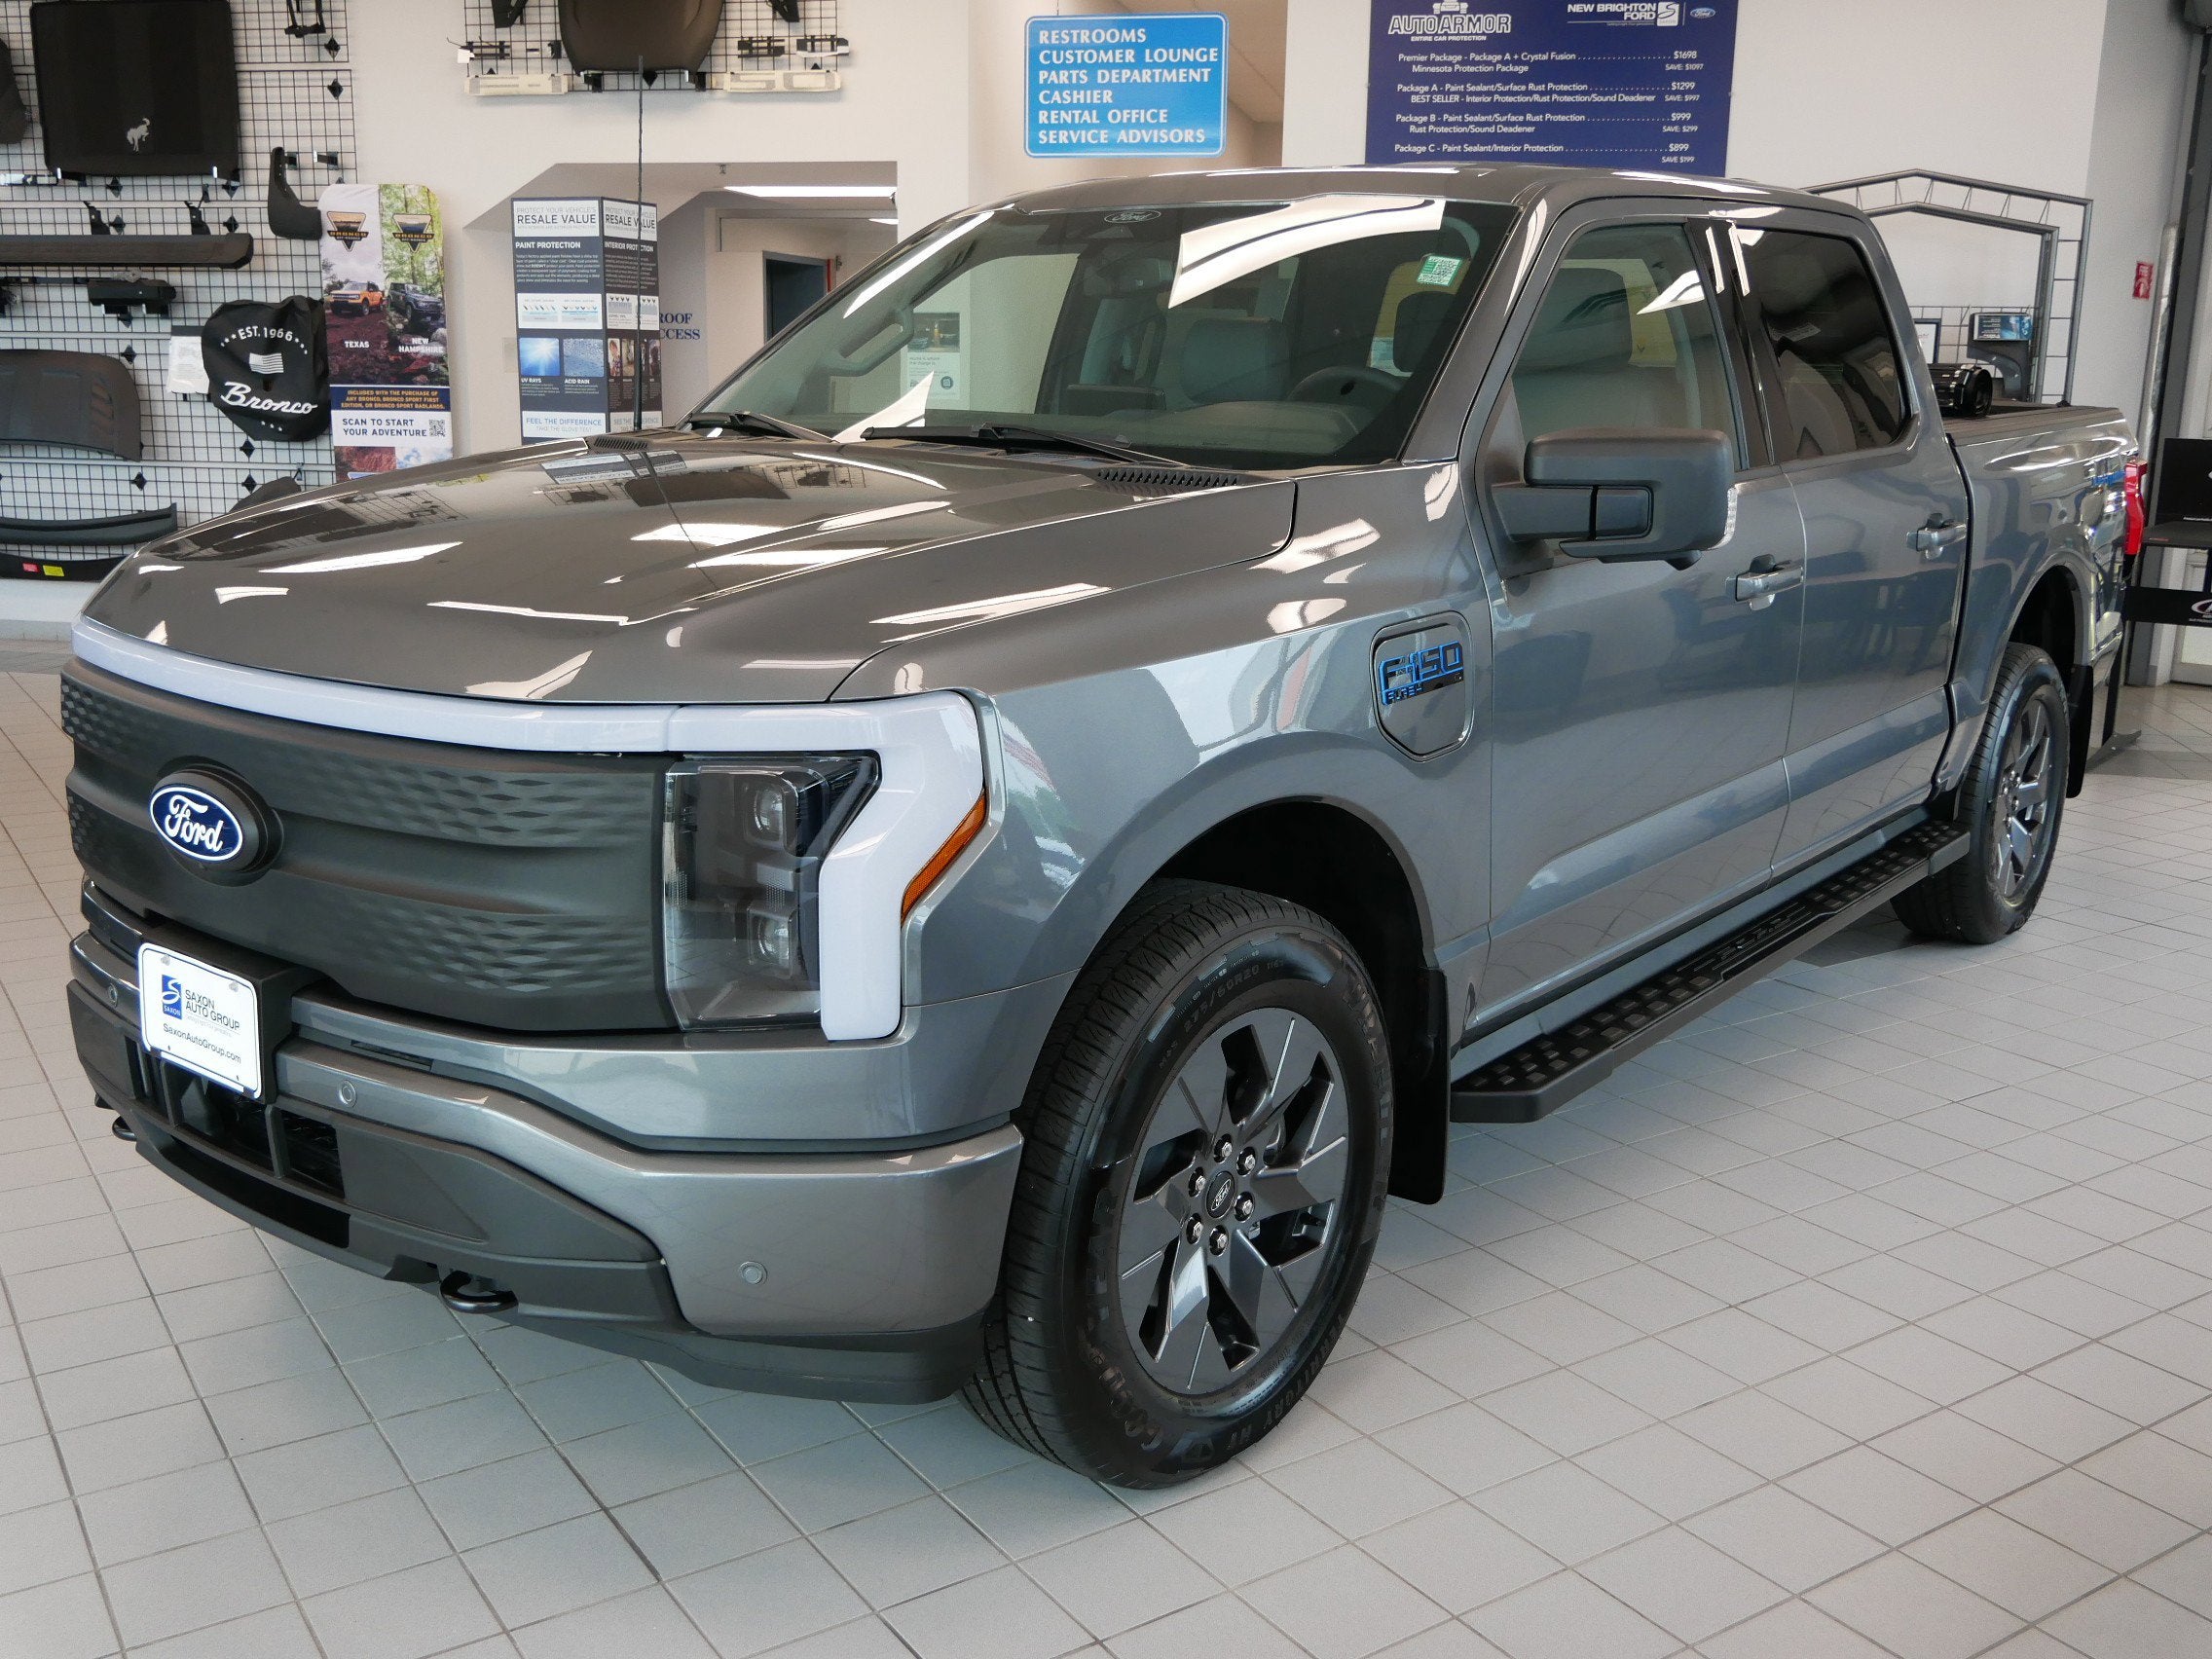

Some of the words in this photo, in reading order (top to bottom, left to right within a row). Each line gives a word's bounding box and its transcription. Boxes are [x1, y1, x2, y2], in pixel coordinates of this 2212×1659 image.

[1567, 3, 1596, 13] NEW
[1597, 2, 1657, 13] BRIGHTON
[1624, 12, 1656, 20] FORD
[1039, 28, 1147, 44] RESTROOMS
[1039, 49, 1135, 64] CUSTOMER
[1145, 47, 1218, 62] LOUNGE
[1398, 53, 1428, 61] Premier
[1429, 53, 1462, 63] Package
[1469, 53, 1502, 63] Package
[1521, 52, 1549, 62] Crystal
[1551, 52, 1576, 60] Fusion
[1674, 51, 1698, 59] $1698
[1412, 64, 1453, 73] Minnesota
[1455, 63, 1494, 72] Protection
[1496, 63, 1530, 74] Package
[1039, 69, 1088, 84] PARTS
[1096, 67, 1211, 84] DEPARTMENT
[1397, 84, 1429, 93] Package
[1466, 83, 1527, 92] Sealant/Surface
[1547, 83, 1588, 92] Protection
[1671, 82, 1696, 91] $1299
[1038, 90, 1113, 104] CASHIER
[1411, 94, 1431, 103] BEST
[1432, 94, 1459, 103] SELLER
[1465, 94, 1492, 103] Interior
[1493, 93, 1550, 103] Protection/Rust
[1551, 93, 1617, 102] Protection/Sound
[1618, 93, 1656, 102] Deadener
[1038, 110, 1100, 124] RENTAL
[1107, 108, 1168, 124] OFFICE
[1396, 114, 1428, 124] Package
[1544, 113, 1586, 122] Protection
[1671, 113, 1692, 122] $999
[1428, 125, 1495, 133] Protection/Sound
[1496, 125, 1535, 133] Deadener
[1038, 129, 1109, 144] SERVICE
[1117, 129, 1205, 143] ADVISORS
[1394, 144, 1427, 155] Package
[1428, 144, 1435, 153] C
[1442, 144, 1461, 153] Paint
[1463, 144, 1522, 153] Sealant/Interior
[1523, 143, 1564, 153] Protection
[1669, 143, 1689, 152] $899
[517, 214, 558, 224] RESALE
[562, 214, 596, 224] VALUE
[606, 213, 632, 227] RESALE
[604, 240, 625, 250] INTERIOR
[238, 325, 261, 340] EST.
[263, 327, 293, 342] 1966
[398, 345, 444, 353] HAMPSHIRE
[220, 381, 318, 415] Bronco
[559, 418, 603, 426] DIFFERENCE
[372, 428, 427, 437] ADVENTURE
[164, 793, 224, 853] Ford
[185, 989, 215, 1011] SAXON
[164, 1005, 181, 1016] SAXON
[185, 1001, 208, 1018] AUTO
[209, 1010, 240, 1031] GROUP
[163, 1022, 242, 1065] SaxonAutoGroup.com
